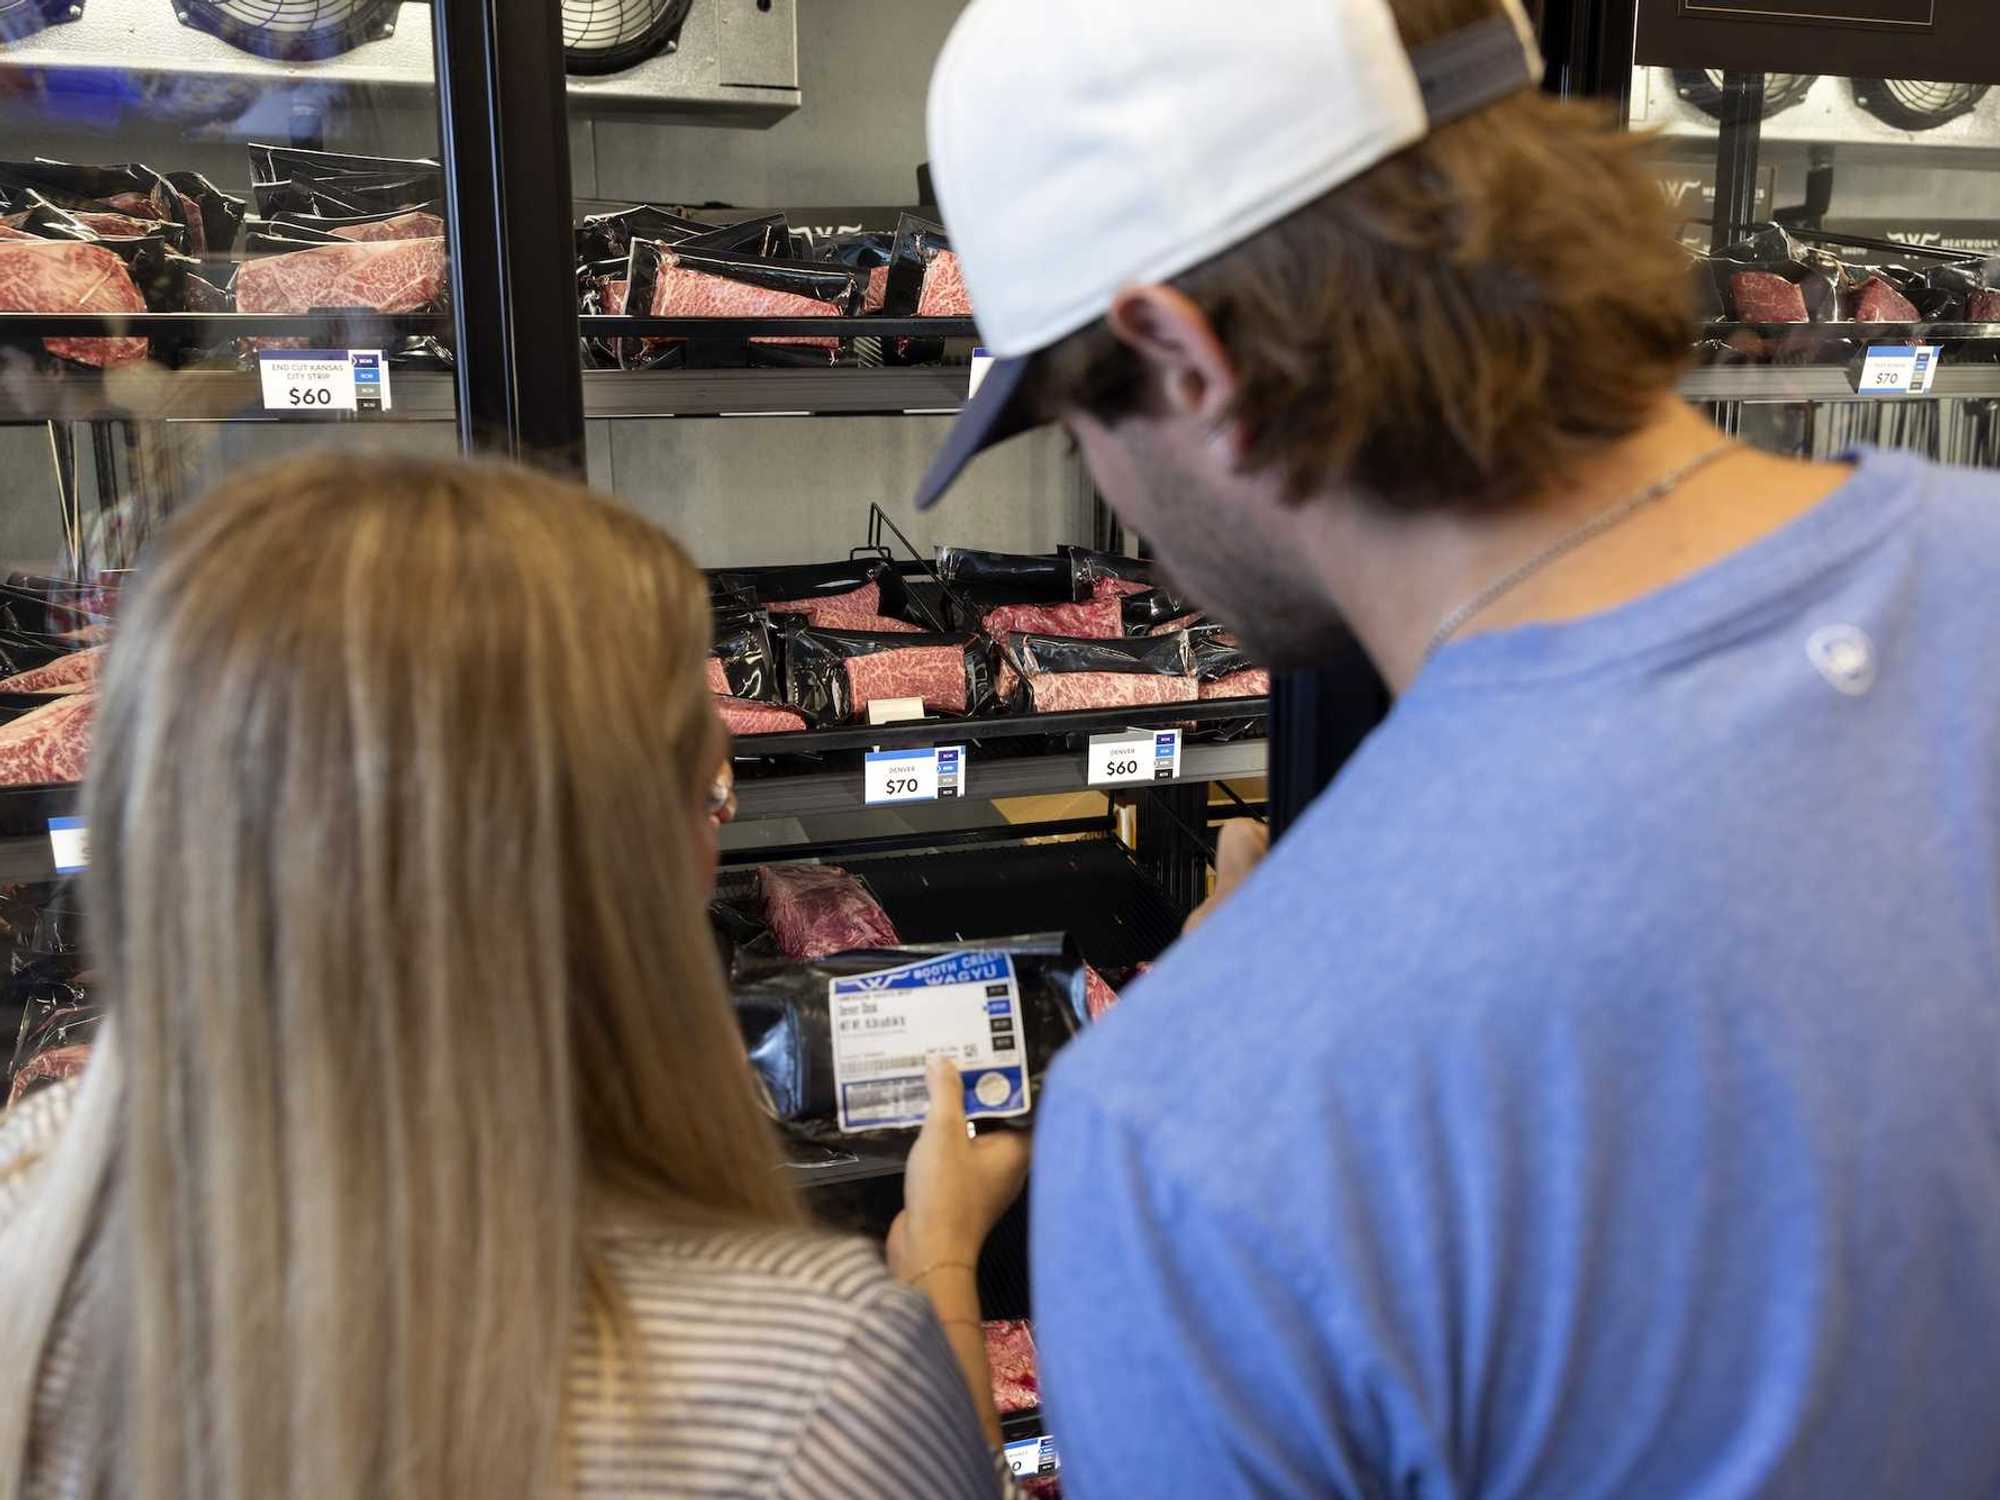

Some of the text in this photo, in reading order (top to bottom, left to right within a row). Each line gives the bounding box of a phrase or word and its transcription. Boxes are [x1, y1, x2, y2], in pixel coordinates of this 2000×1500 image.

[291, 364, 308, 372] CUT
[310, 364, 344, 372] KANSAS
[1875, 372, 1898, 385] $70
[289, 387, 331, 406] $60
[1110, 748, 1135, 756] DENVER
[888, 765, 916, 774] DENVER
[1106, 760, 1138, 776] $60
[885, 778, 918, 795] $70
[913, 960, 957, 979] BOOTH
[924, 963, 997, 985] WAGYU
